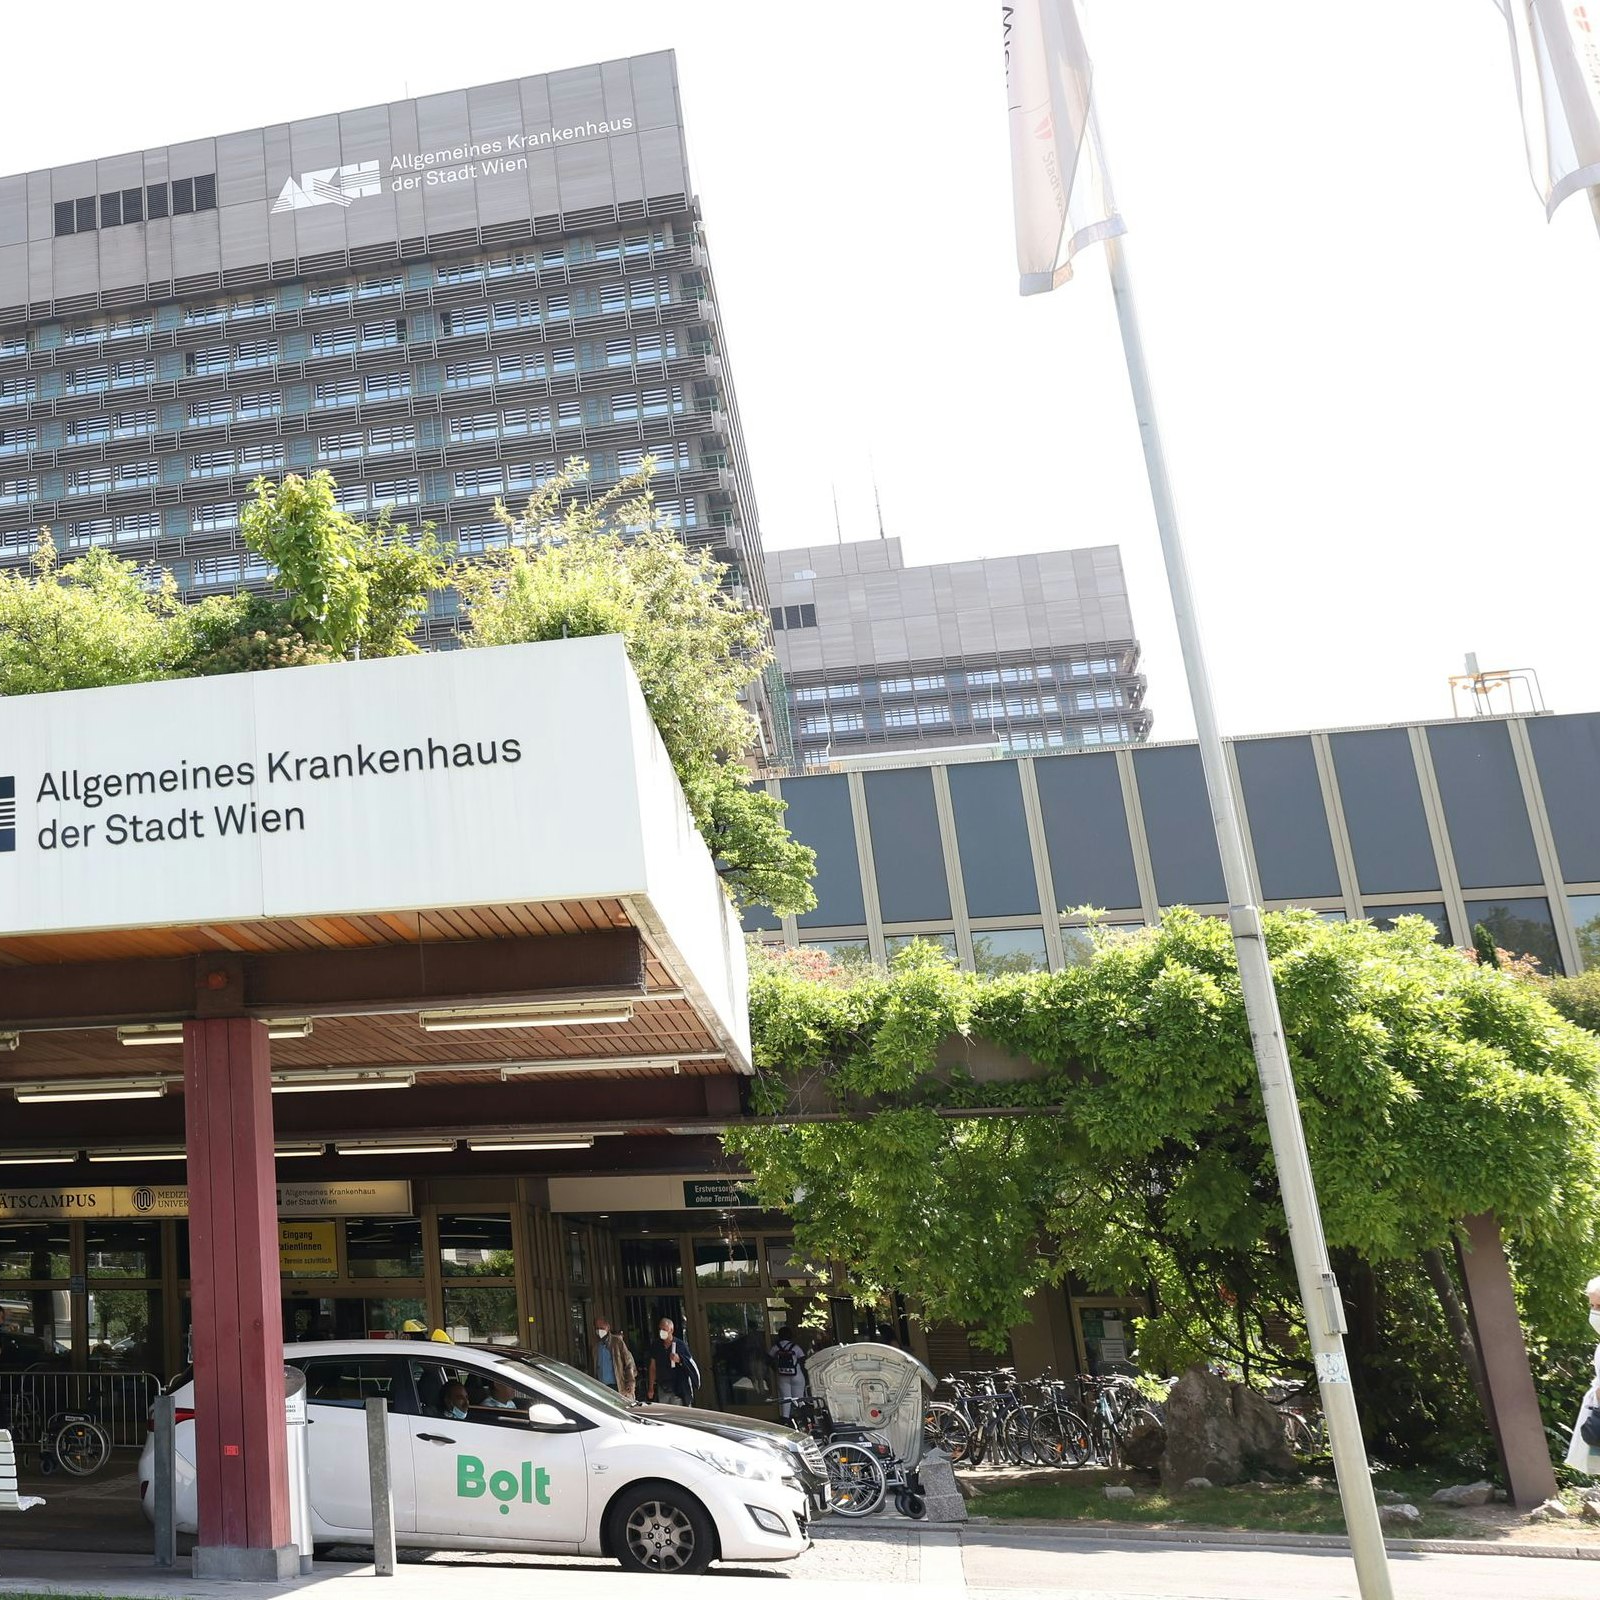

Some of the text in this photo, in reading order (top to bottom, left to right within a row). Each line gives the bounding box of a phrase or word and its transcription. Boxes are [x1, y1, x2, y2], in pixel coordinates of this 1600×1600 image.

[389, 116, 633, 171] Allgemeines Krankenhaus
[390, 156, 528, 193] der Stadt Wien
[36, 737, 523, 808] Allgemeines Krankenhaus
[37, 800, 305, 851] der Stadt Wien
[285, 1187, 376, 1198] Allgemeines Krankenhaus
[285, 1198, 337, 1206] der Stadt Wien
[695, 1194, 737, 1203] ohne Termin
[283, 1230, 313, 1241] Eingang
[280, 1242, 322, 1251] atientInnen
[284, 1257, 302, 1265] Termin
[457, 1453, 551, 1515] Bolt
